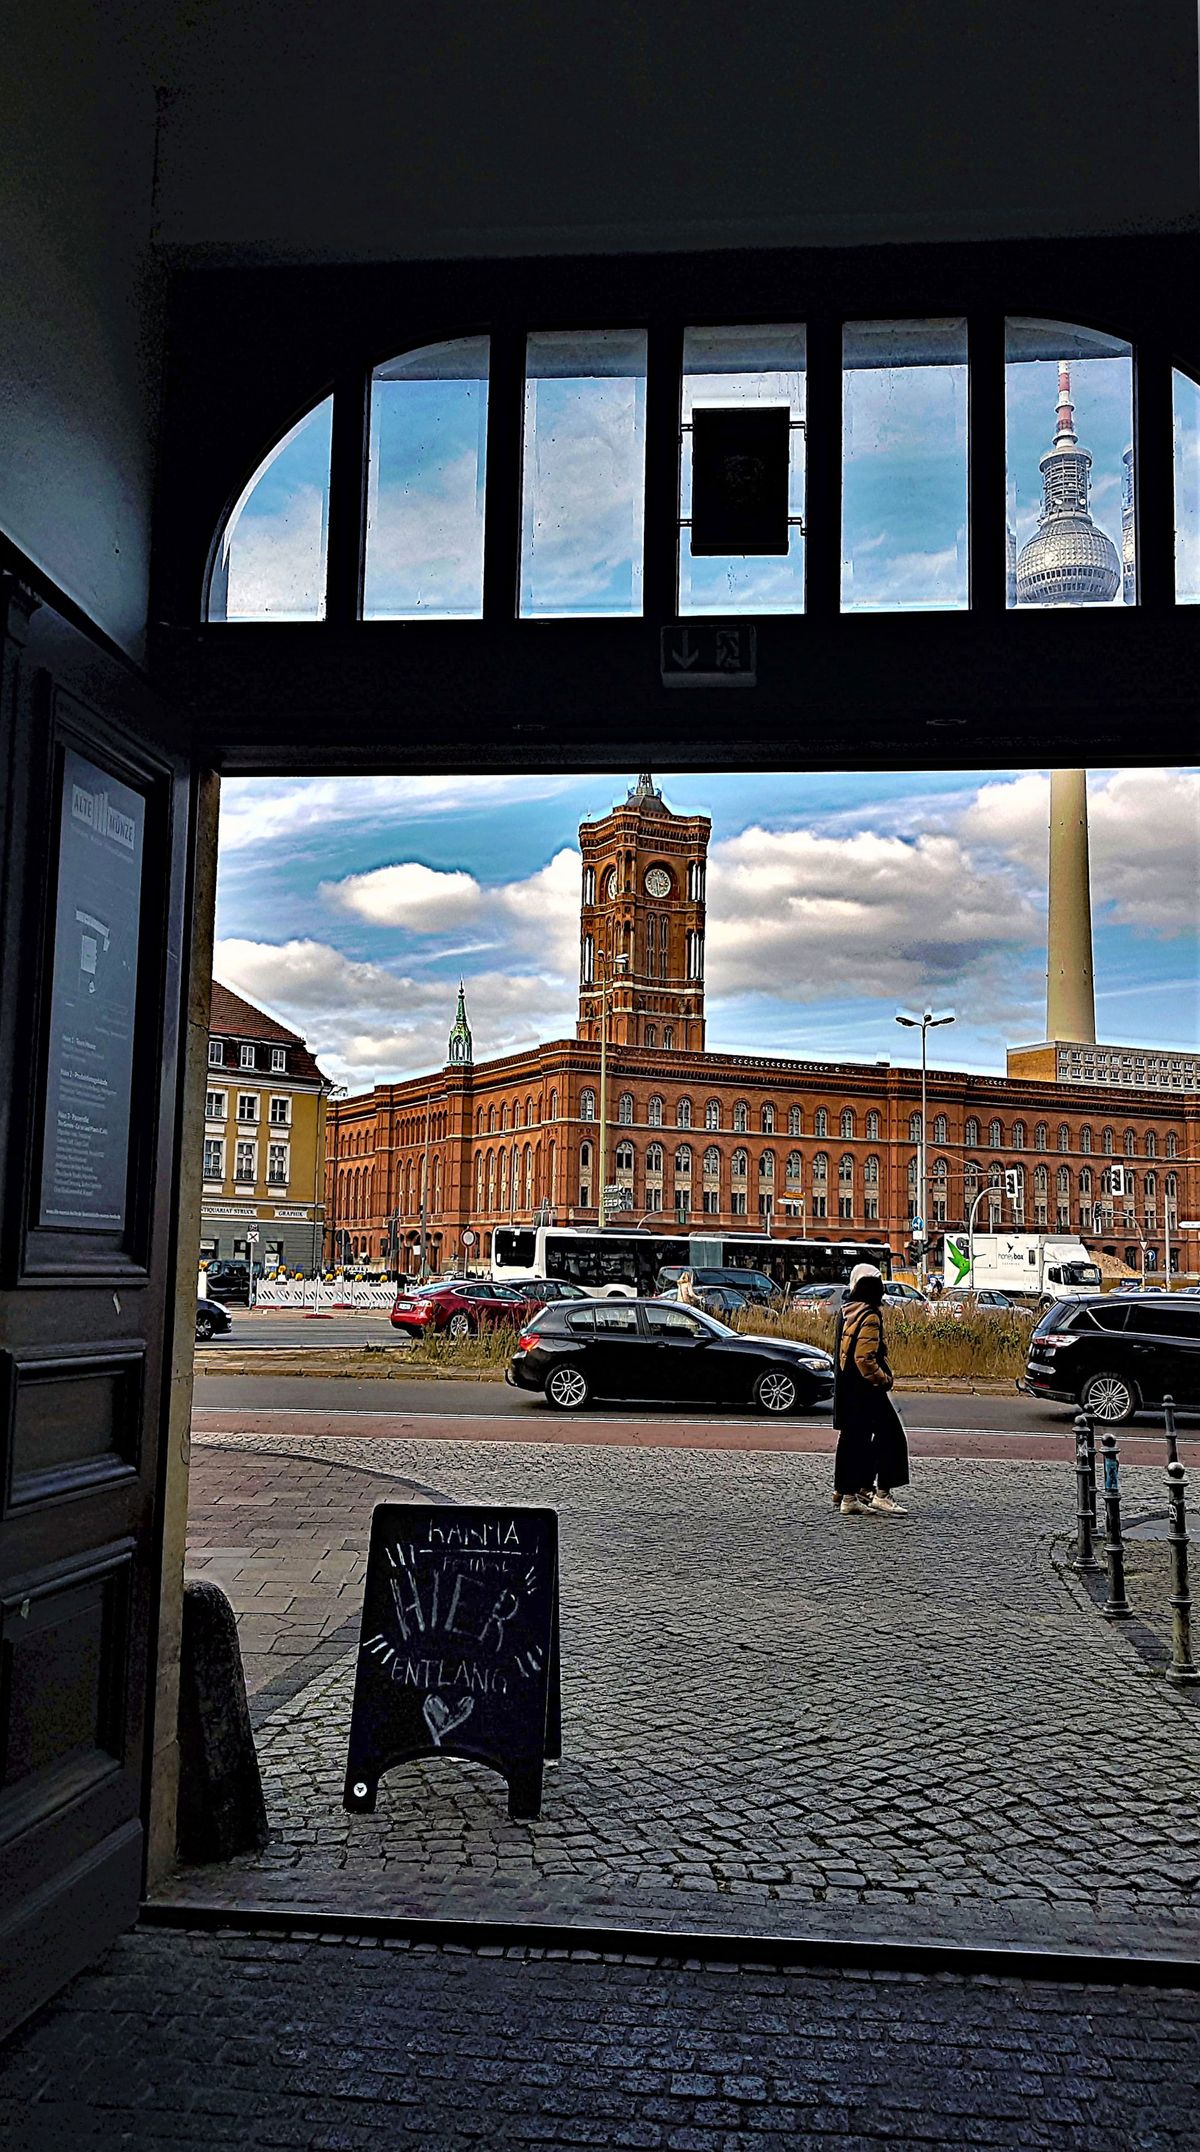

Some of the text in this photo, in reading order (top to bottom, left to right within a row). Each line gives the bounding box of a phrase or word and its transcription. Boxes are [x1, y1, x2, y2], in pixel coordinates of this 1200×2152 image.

[74, 793, 133, 842] ALTE MÜNZE
[389, 1570, 519, 1652] HIER
[391, 1656, 508, 1694] ENTLANG
